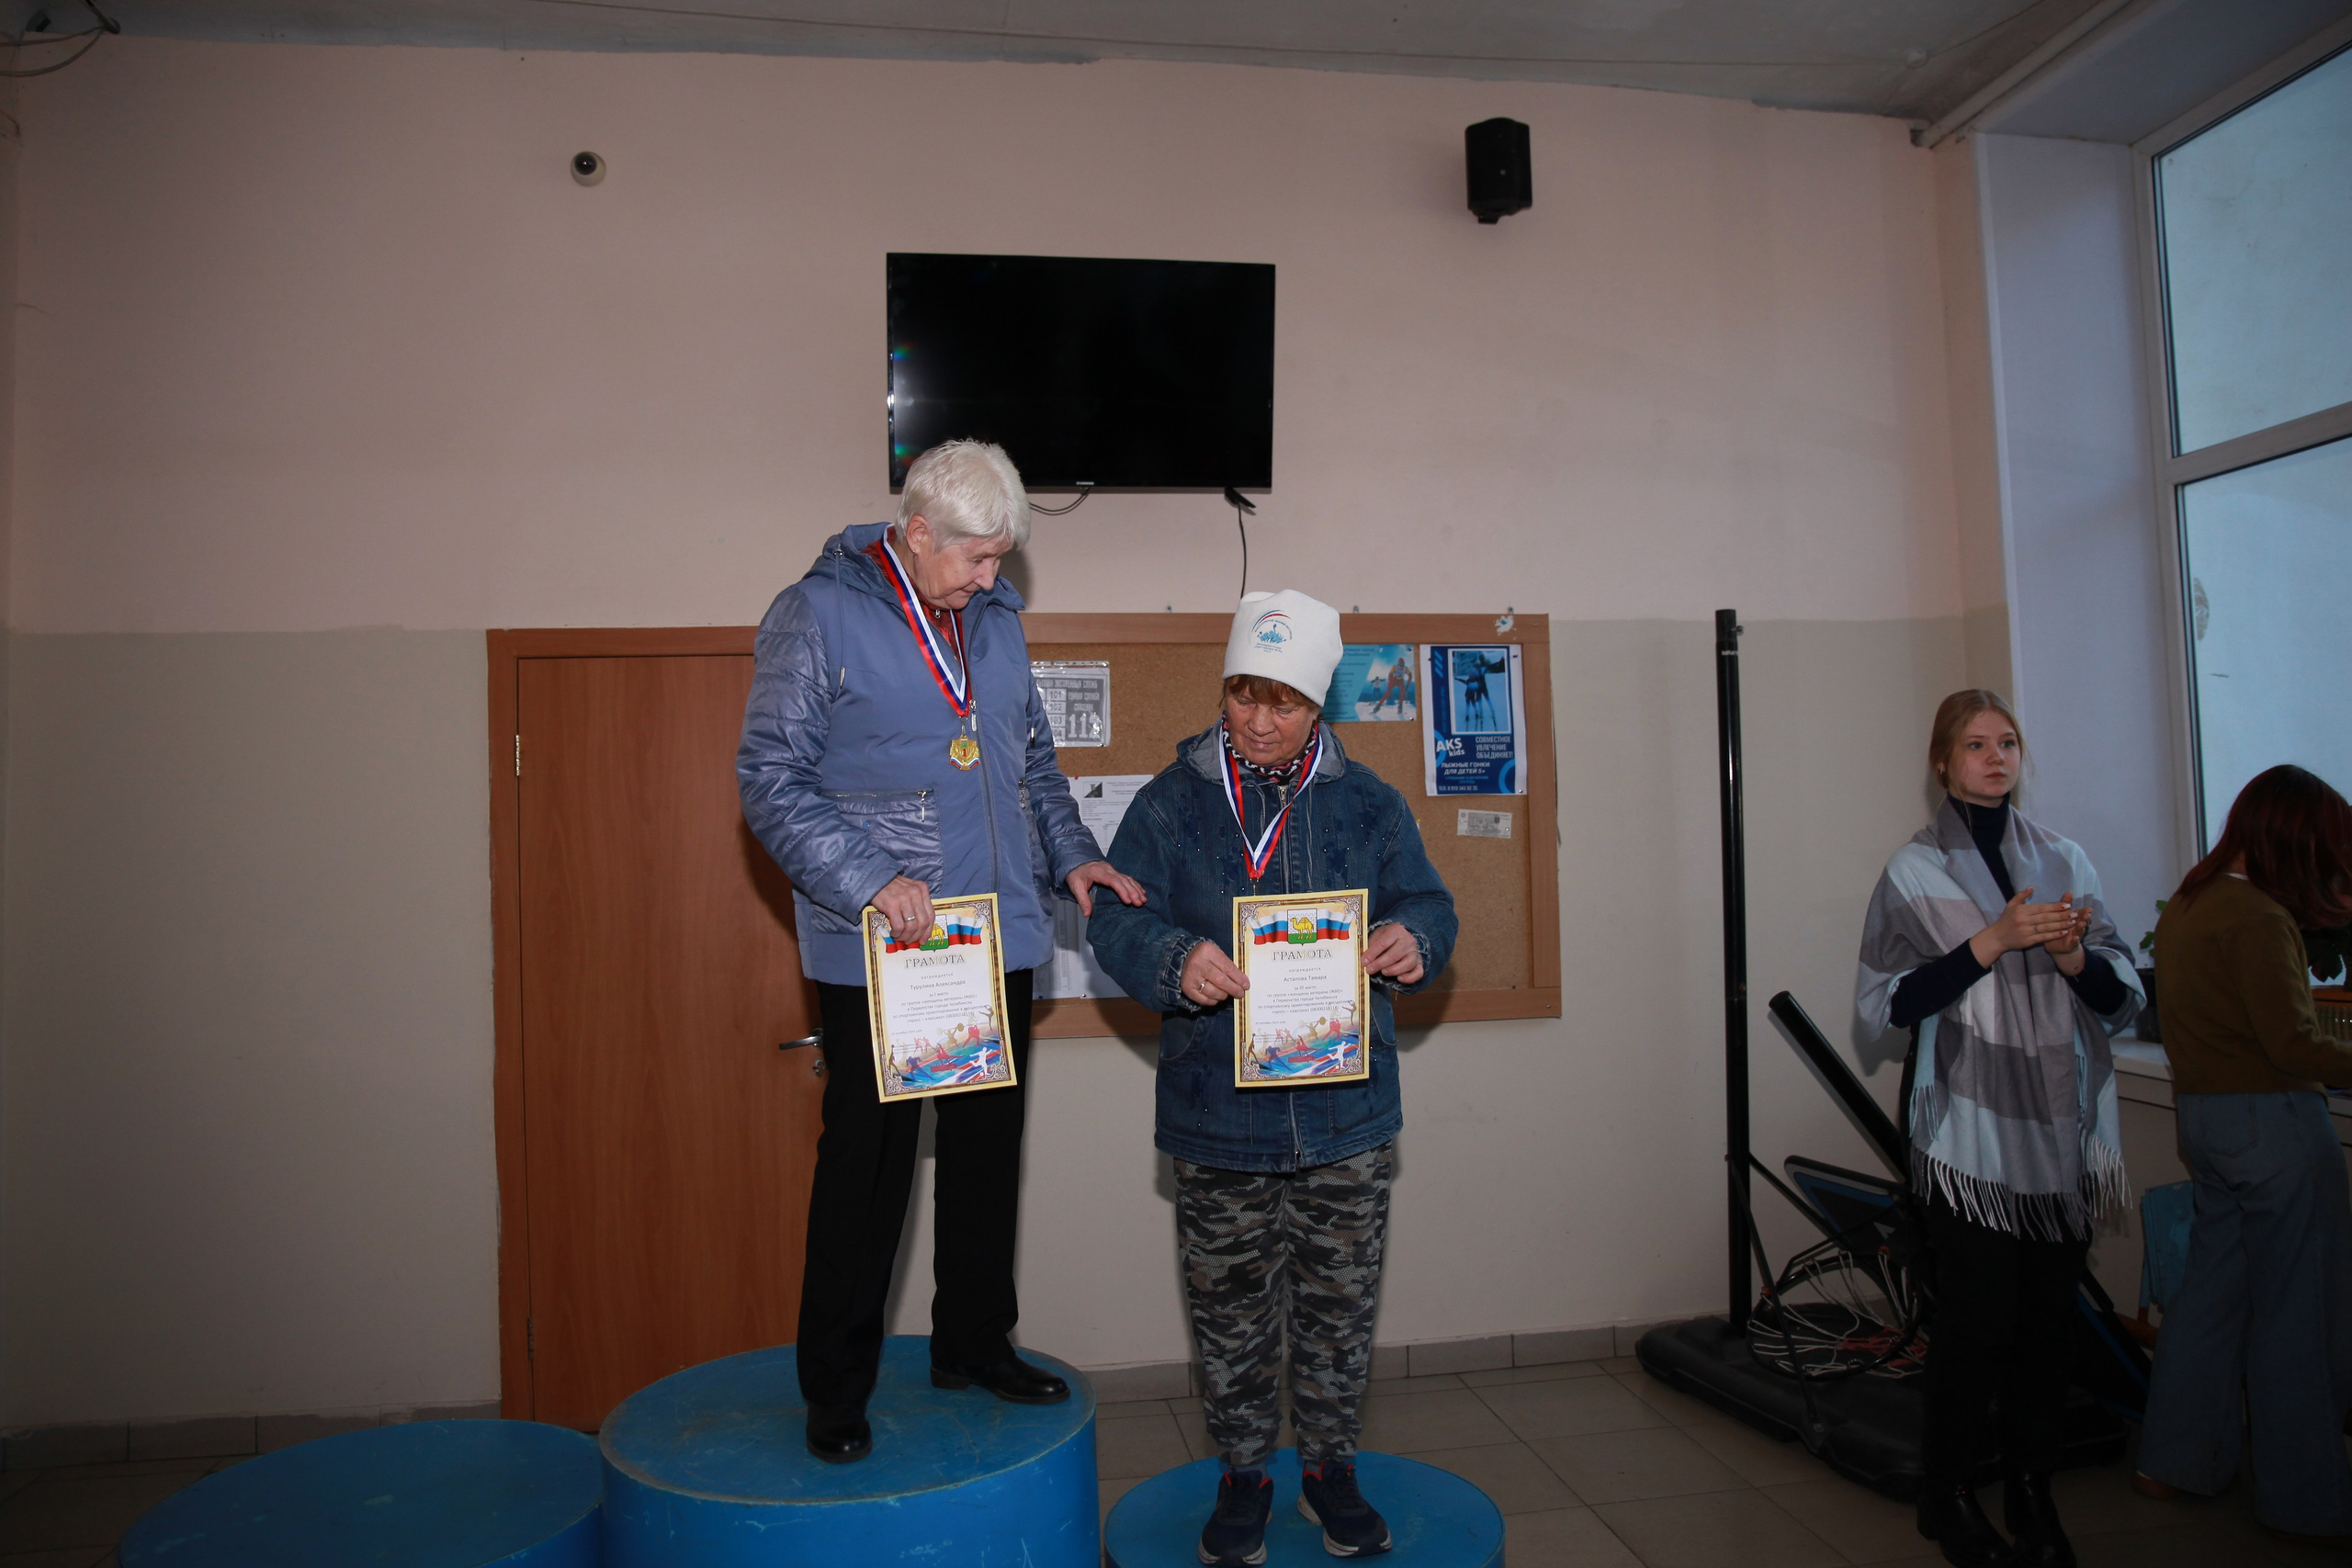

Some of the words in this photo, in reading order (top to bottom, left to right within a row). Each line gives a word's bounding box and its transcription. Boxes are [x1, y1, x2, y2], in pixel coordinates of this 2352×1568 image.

[1068, 713, 1101, 739] 112
[1436, 738, 1463, 752] AKS
[1449, 749, 1465, 757] kids
[905, 954, 966, 968] ГРАМОТА
[1272, 949, 1332, 961] ГРАМОТА
